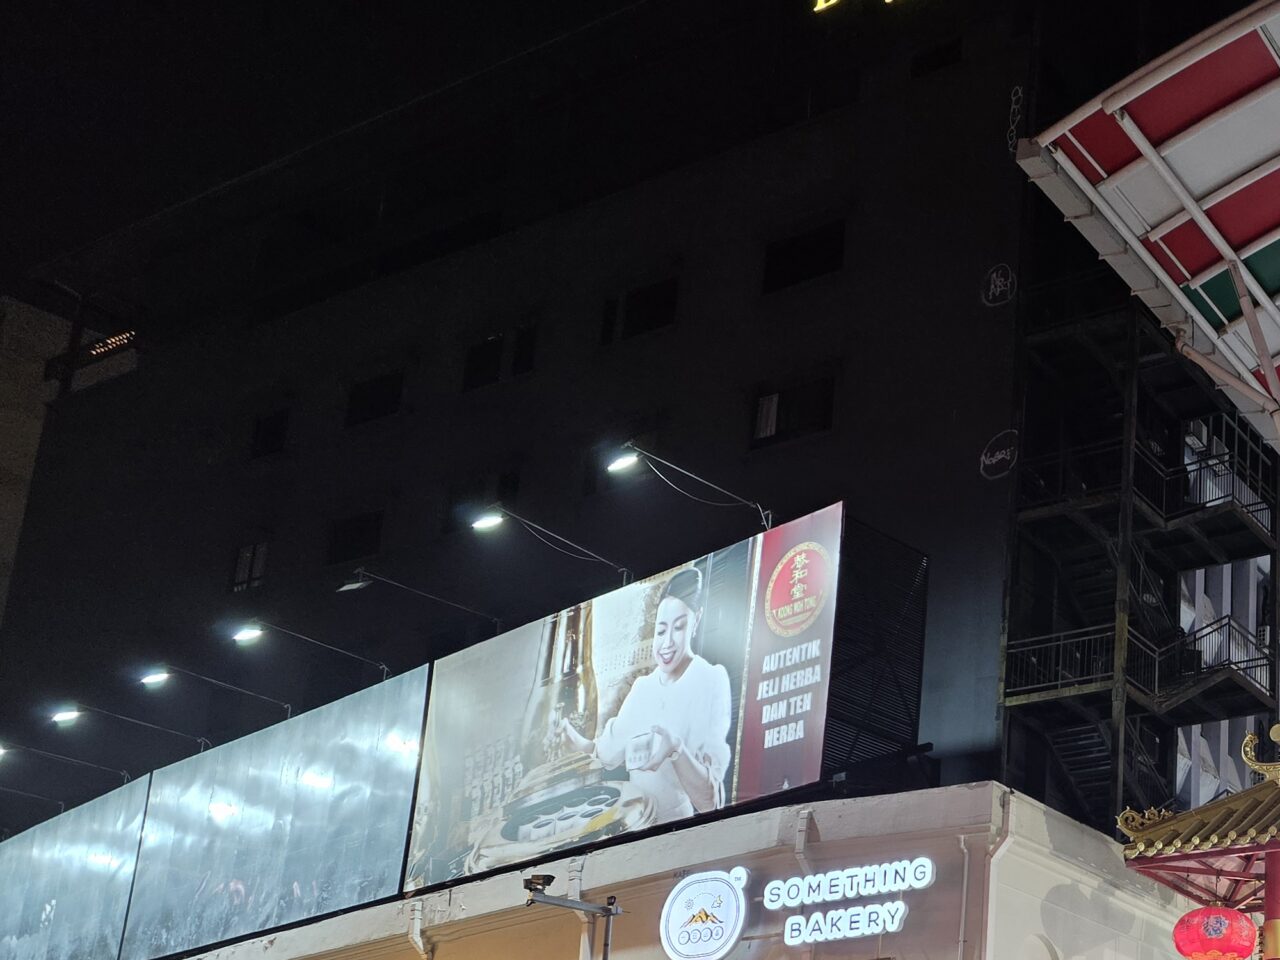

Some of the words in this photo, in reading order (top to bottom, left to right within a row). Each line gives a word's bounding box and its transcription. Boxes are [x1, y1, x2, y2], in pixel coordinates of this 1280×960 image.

[762, 639, 820, 673] AUTENTIK
[757, 675, 780, 701] JELI
[781, 666, 821, 693] HERBA
[762, 698, 788, 724] DAN
[789, 693, 811, 716] TEH
[764, 719, 805, 749] HERBA
[768, 864, 929, 905] SOMETHING
[788, 907, 901, 941] BAKERY
